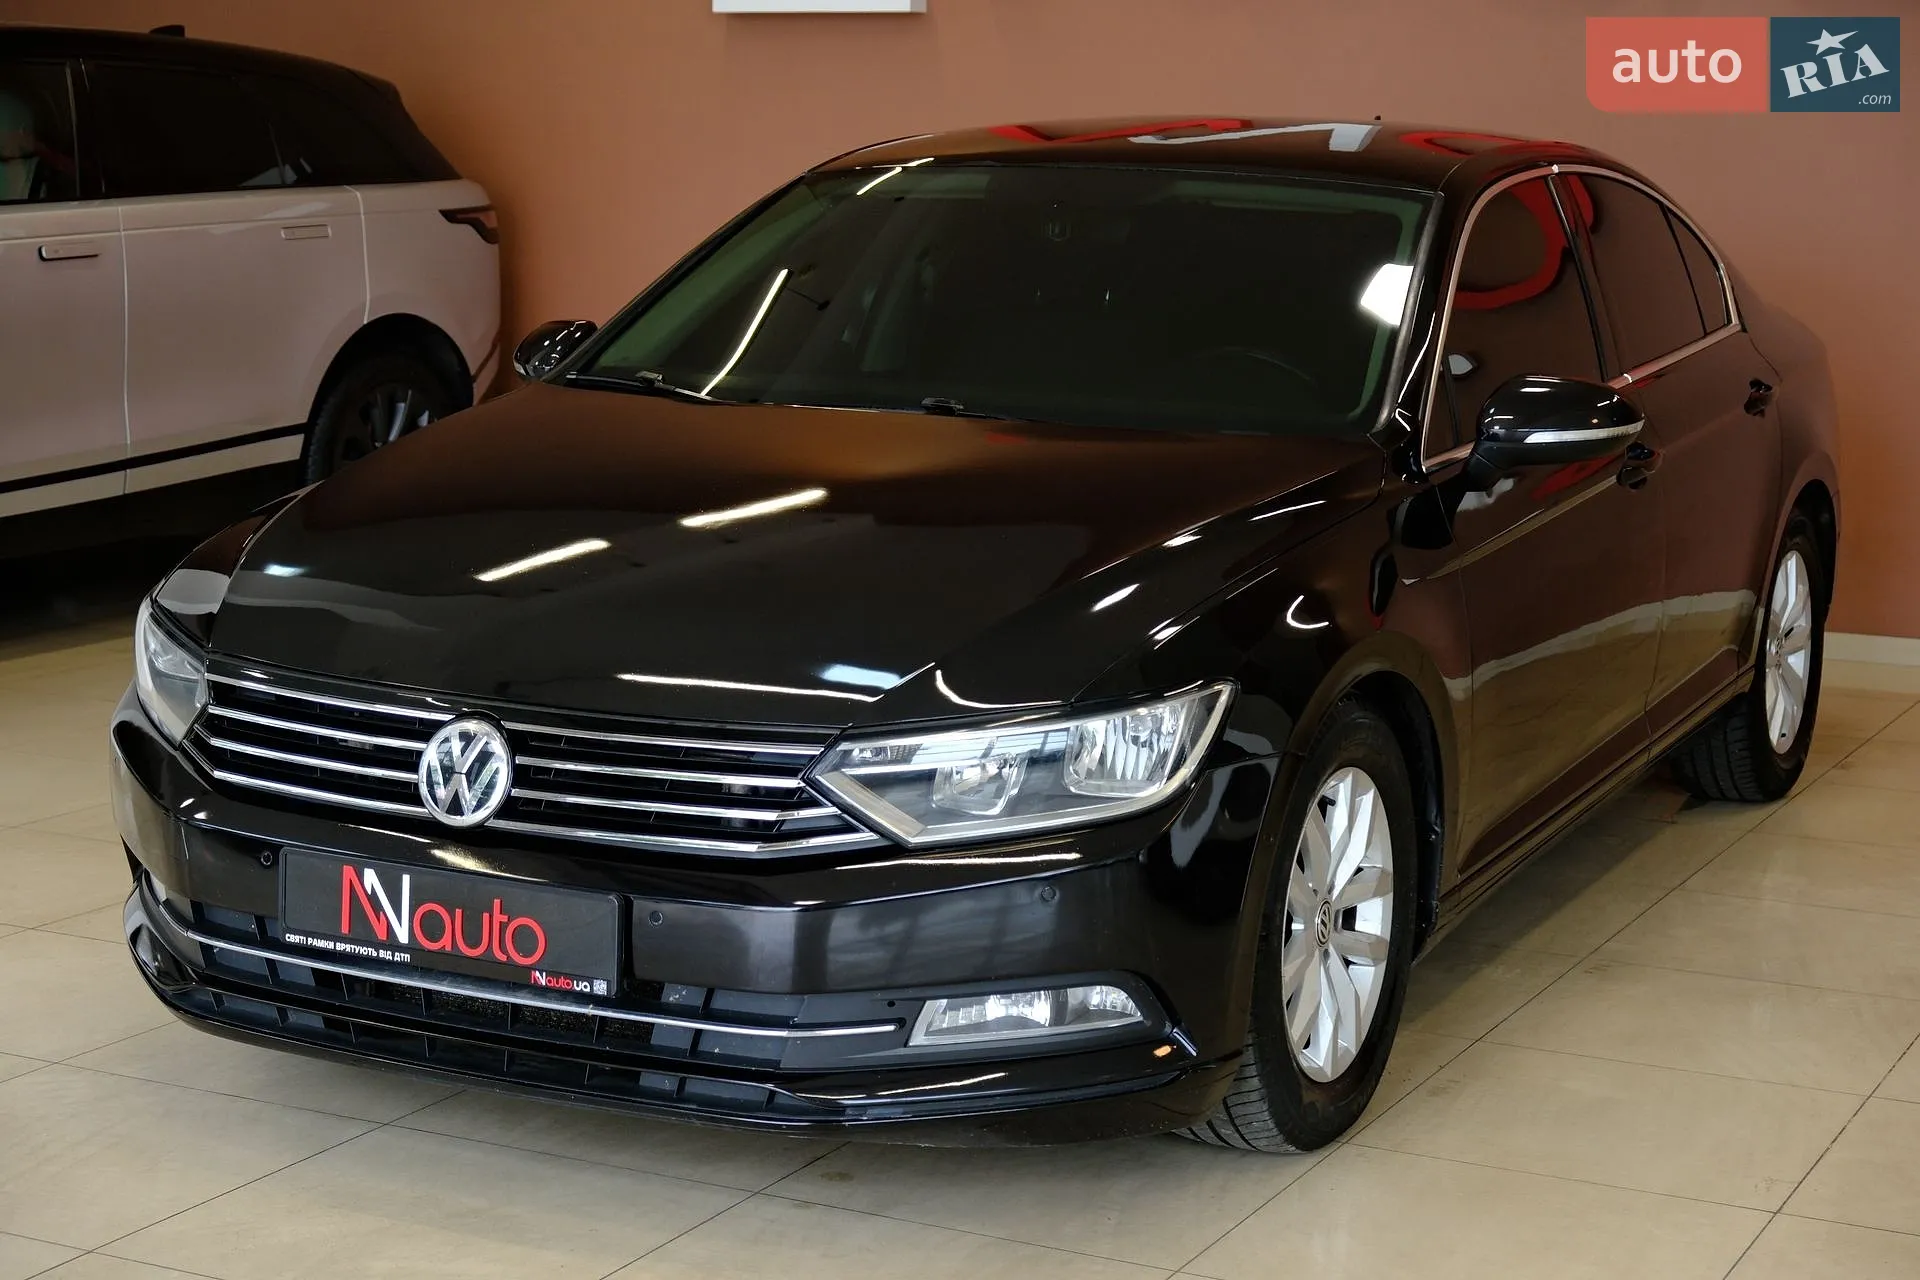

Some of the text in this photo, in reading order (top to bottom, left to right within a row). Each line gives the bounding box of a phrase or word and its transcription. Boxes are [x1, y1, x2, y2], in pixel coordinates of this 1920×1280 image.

[285, 933, 411, 963] СВЯТІ РАМКИ ВРЯТУЮТЬ ВІД ДТП
